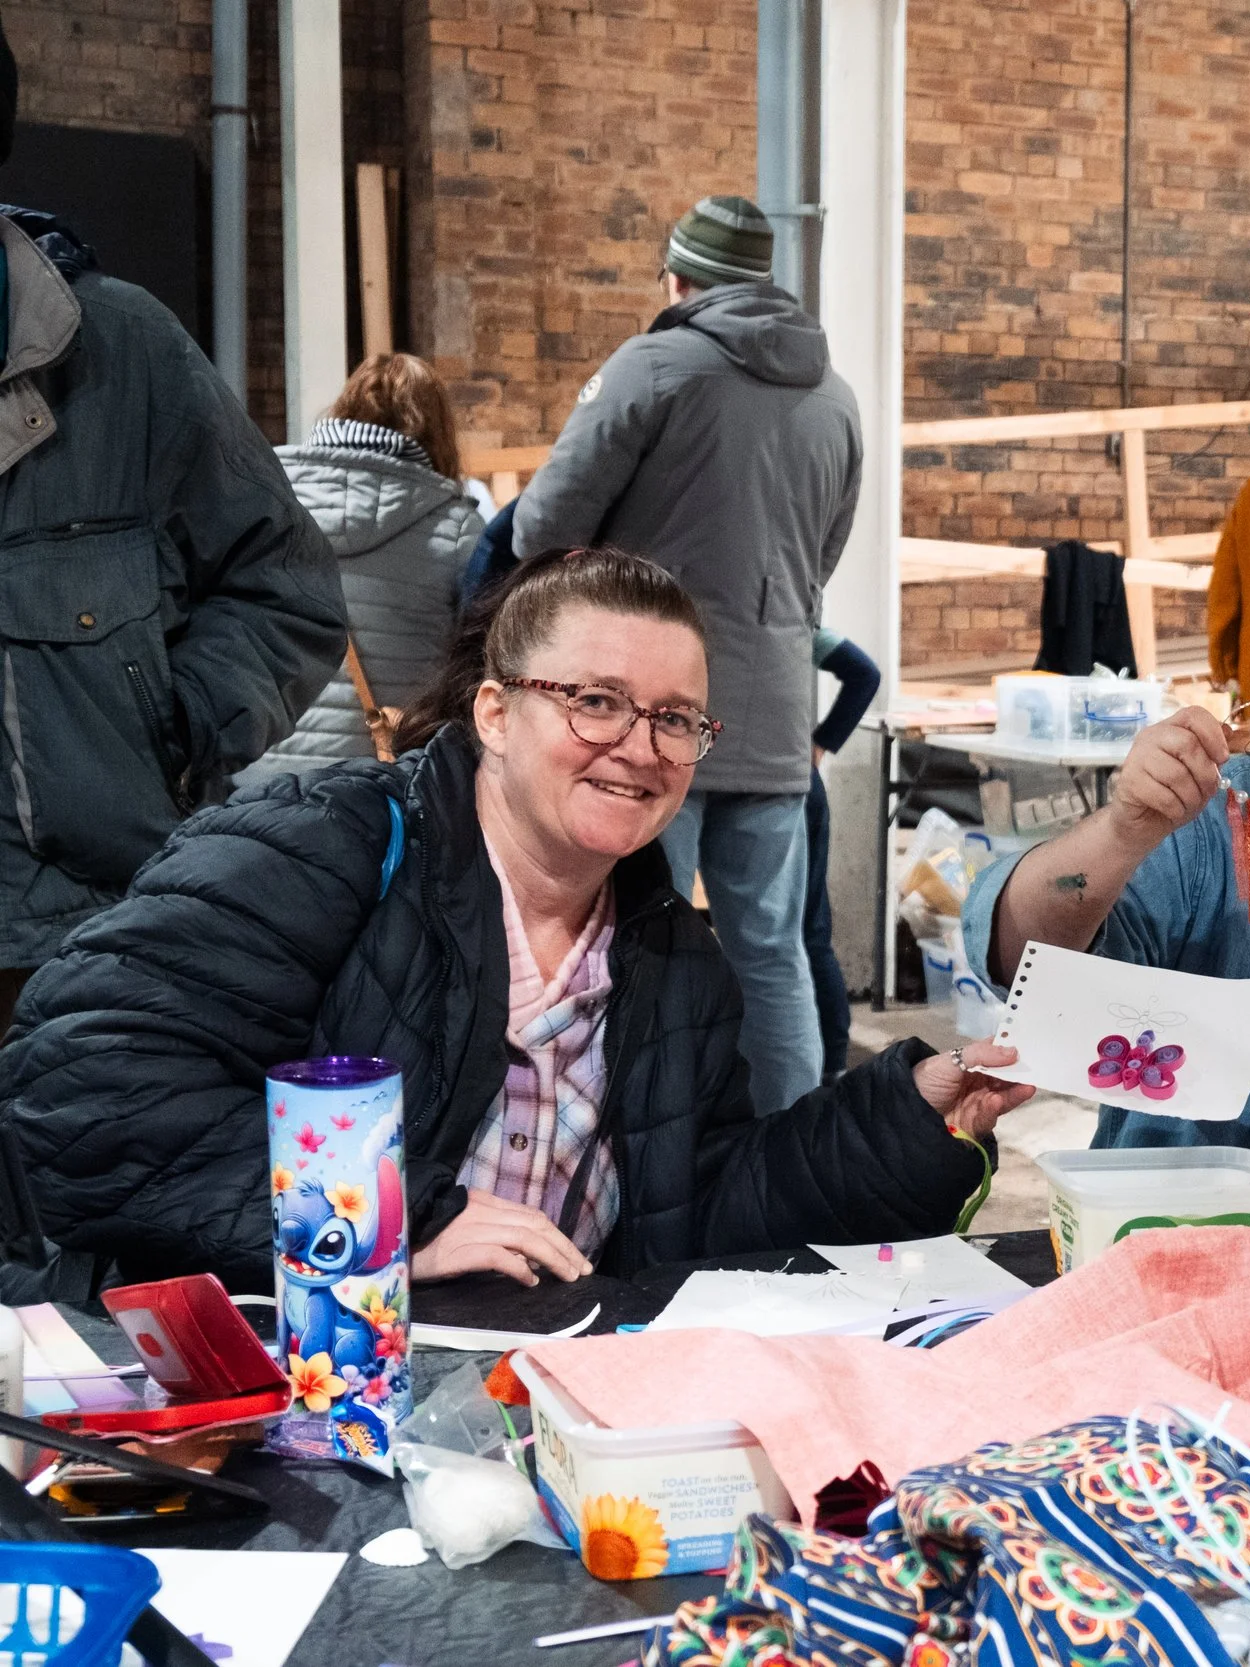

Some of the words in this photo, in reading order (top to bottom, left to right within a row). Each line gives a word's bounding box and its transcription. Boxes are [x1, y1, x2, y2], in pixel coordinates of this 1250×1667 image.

[538, 1409, 579, 1496] FLORA
[661, 1477, 699, 1489] TOAST
[697, 1495, 737, 1507] SWEET
[670, 1507, 734, 1521] POTATOES
